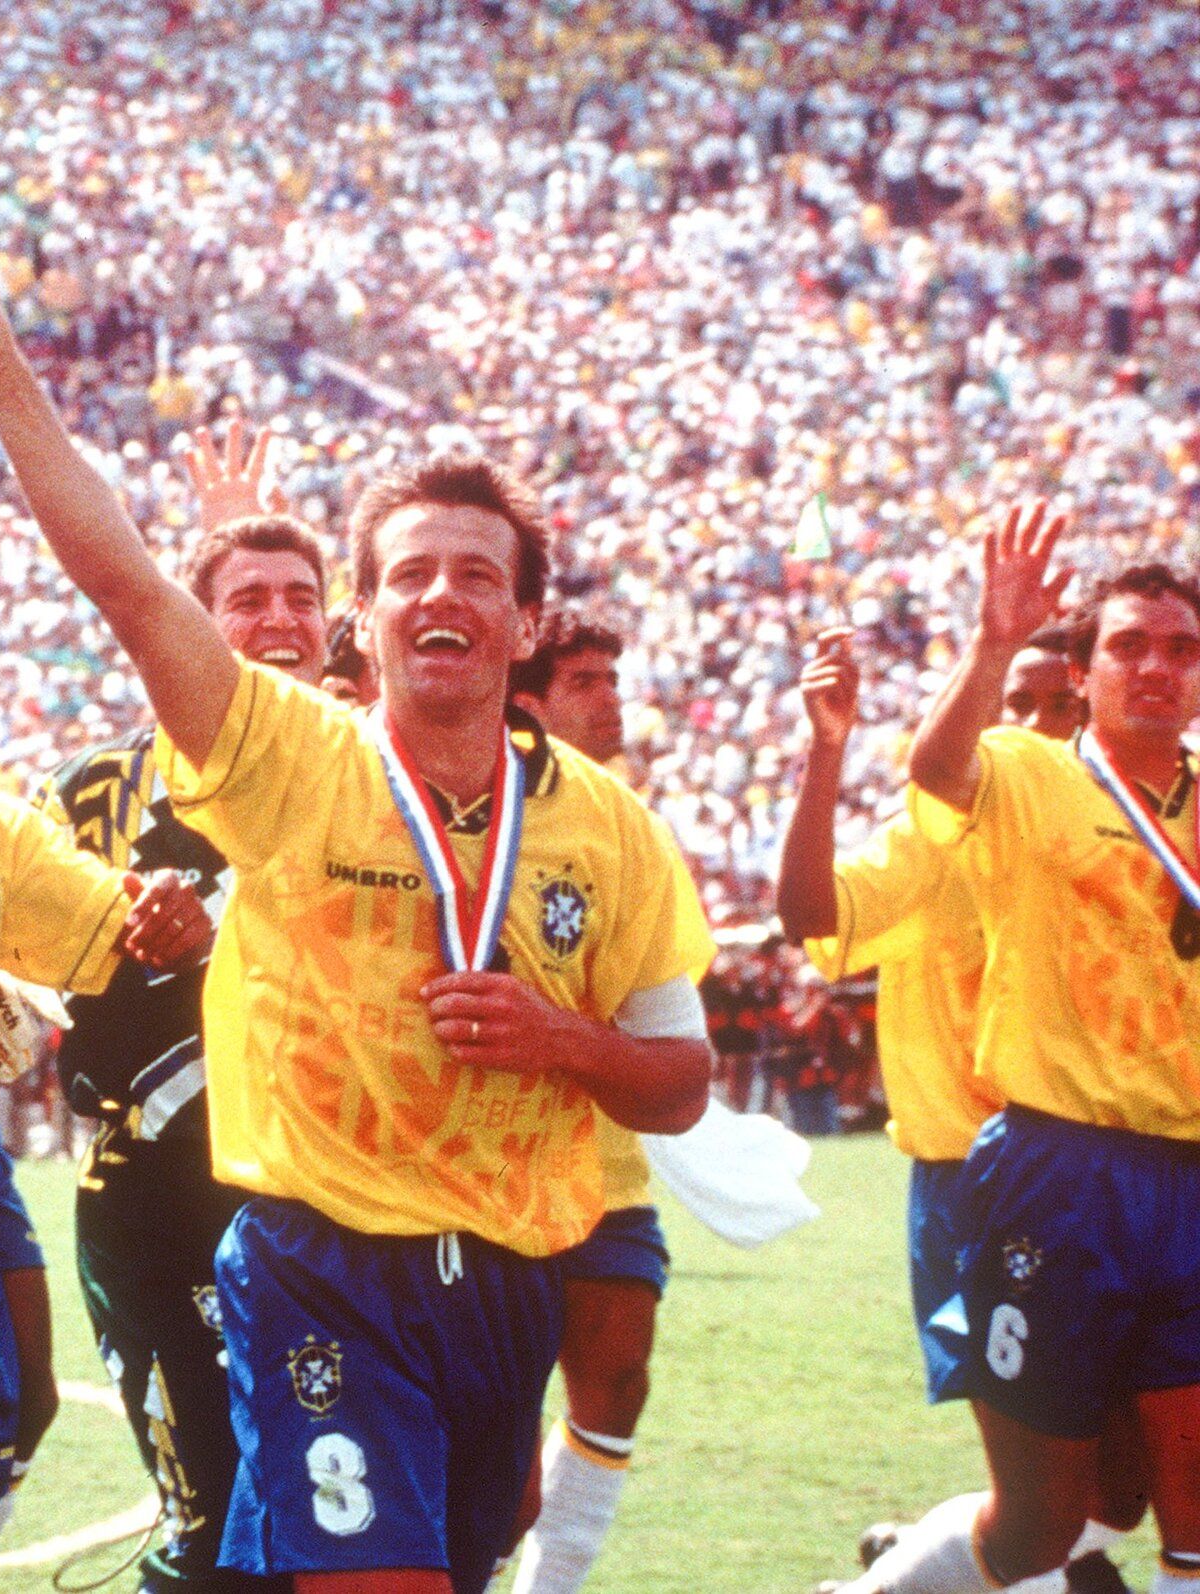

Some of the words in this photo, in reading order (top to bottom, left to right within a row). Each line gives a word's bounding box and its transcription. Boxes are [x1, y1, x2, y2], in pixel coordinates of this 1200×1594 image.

[325, 861, 421, 891] UMBRO
[986, 1303, 1029, 1381] 6
[305, 1432, 377, 1537] 8
